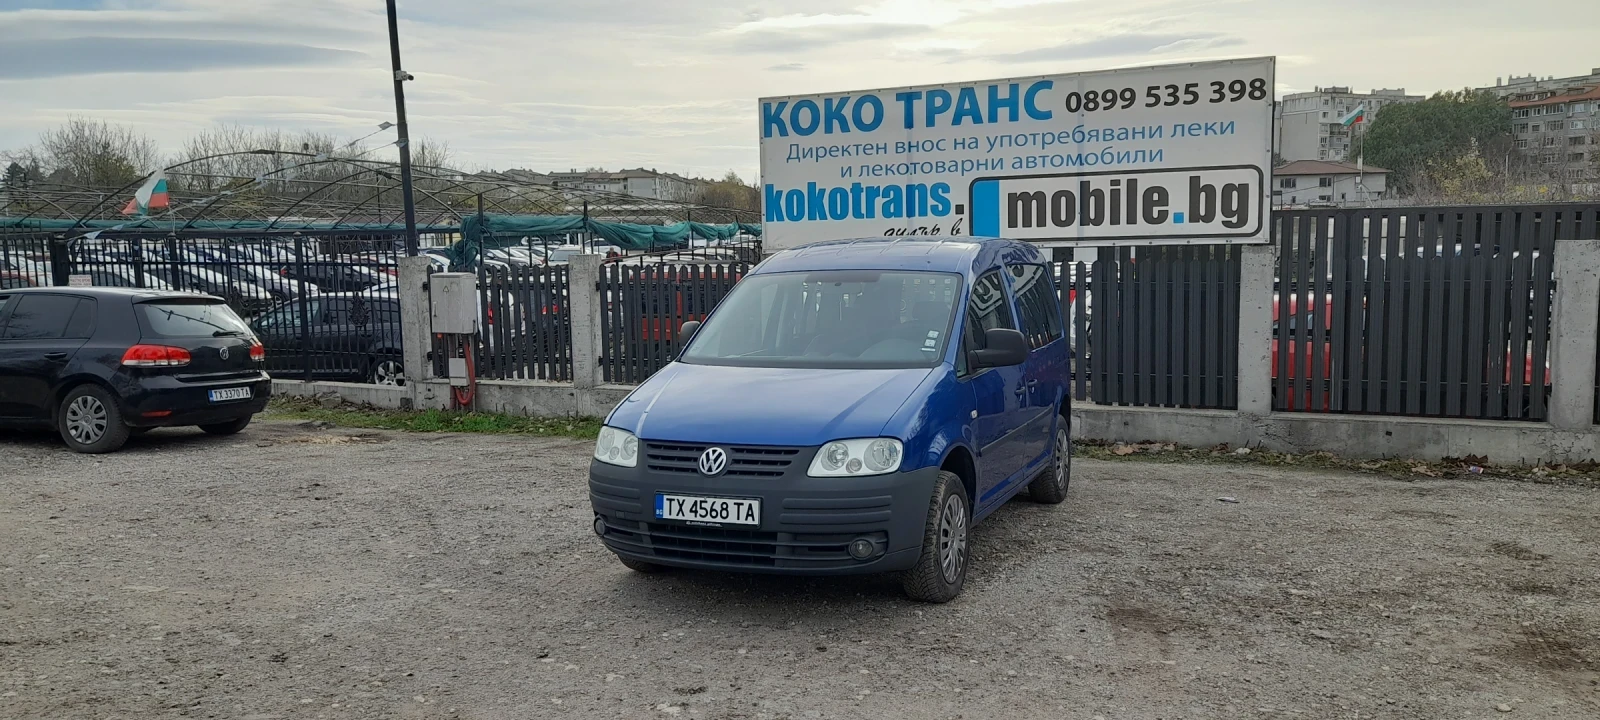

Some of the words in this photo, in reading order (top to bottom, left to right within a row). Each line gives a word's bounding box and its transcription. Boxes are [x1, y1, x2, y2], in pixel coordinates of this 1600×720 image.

[762, 94, 885, 138] КОКО
[895, 80, 1054, 130] ТРАНС
[1065, 87, 1137, 113] 0899
[1145, 83, 1200, 108] 535
[1208, 78, 1267, 103] 398
[786, 141, 887, 163] Директен
[895, 138, 947, 154] внос
[953, 136, 980, 150] на
[985, 124, 1163, 153] употребявани
[1170, 120, 1236, 138] леки
[840, 165, 852, 178] и
[858, 156, 1005, 177] лекотоварни
[1011, 148, 1164, 170] автомобили
[1007, 175, 1250, 229] mobile.bg
[666, 498, 686, 517] TX
[689, 499, 730, 520] 4568
[733, 502, 755, 522] TA
